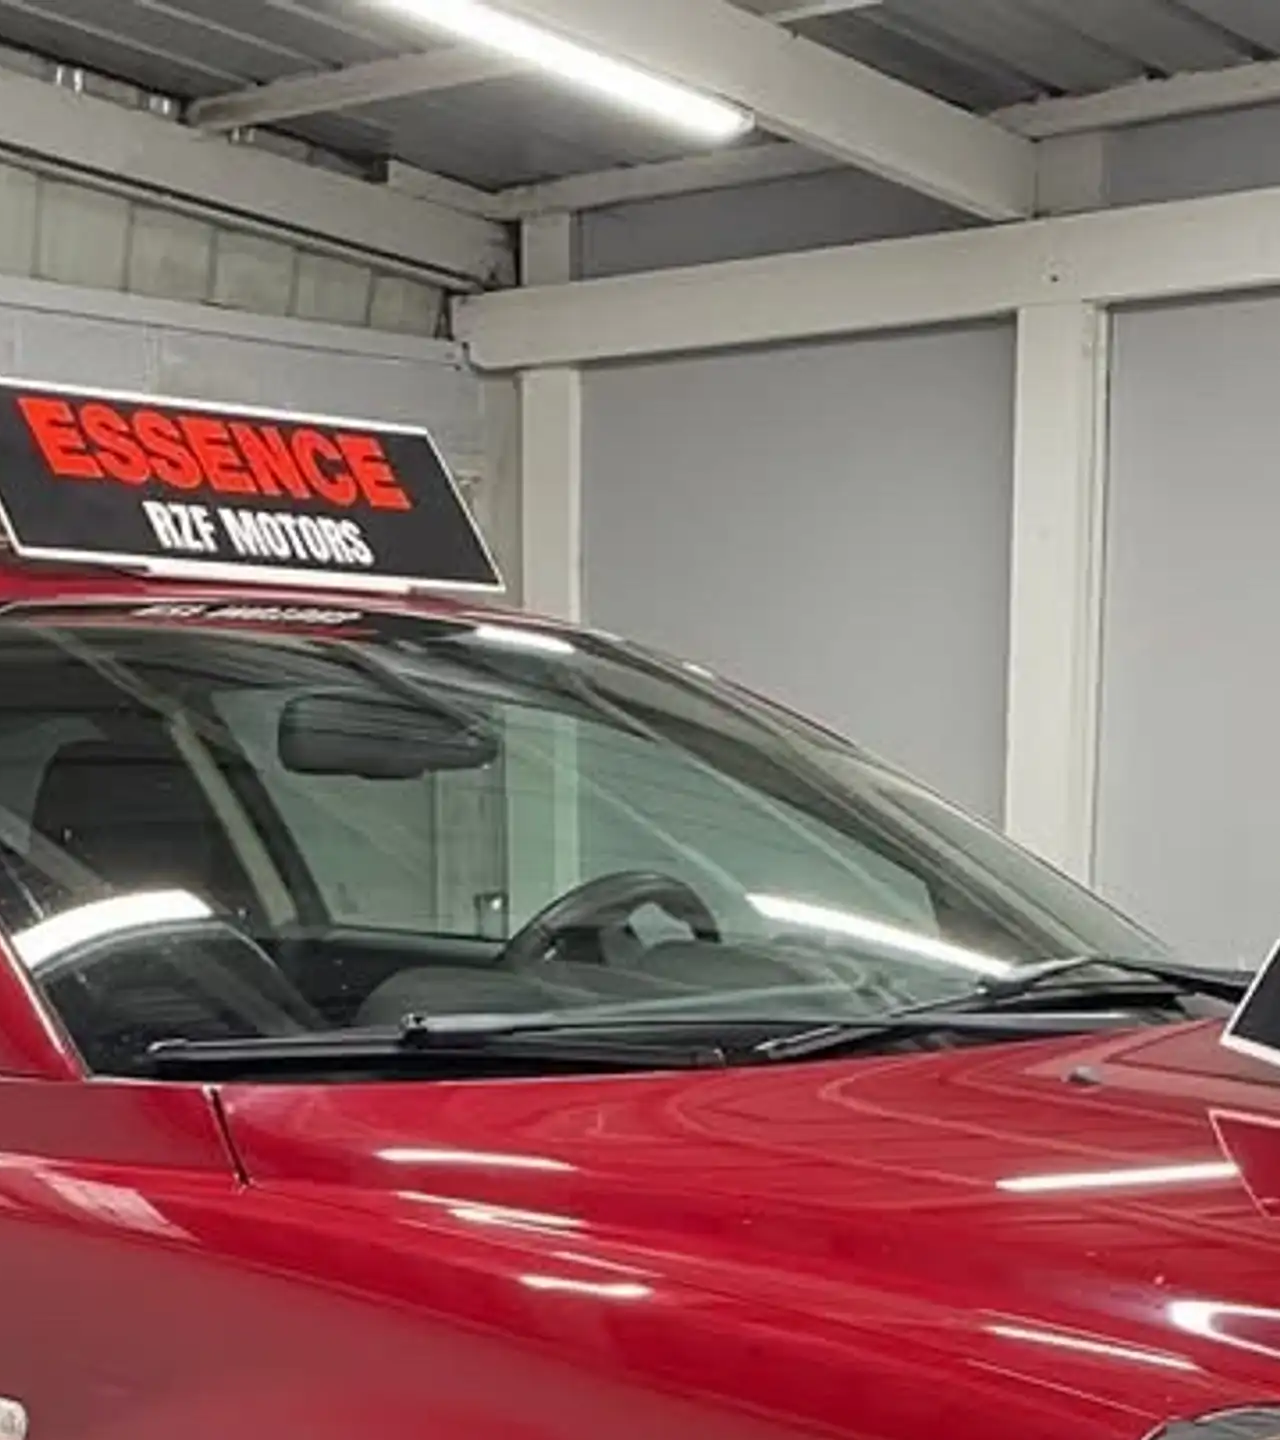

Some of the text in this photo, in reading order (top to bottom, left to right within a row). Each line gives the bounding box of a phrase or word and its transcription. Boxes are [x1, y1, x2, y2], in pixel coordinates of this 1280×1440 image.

[17, 397, 411, 510] ESSENCE
[143, 500, 374, 566] RZF MOTORS
